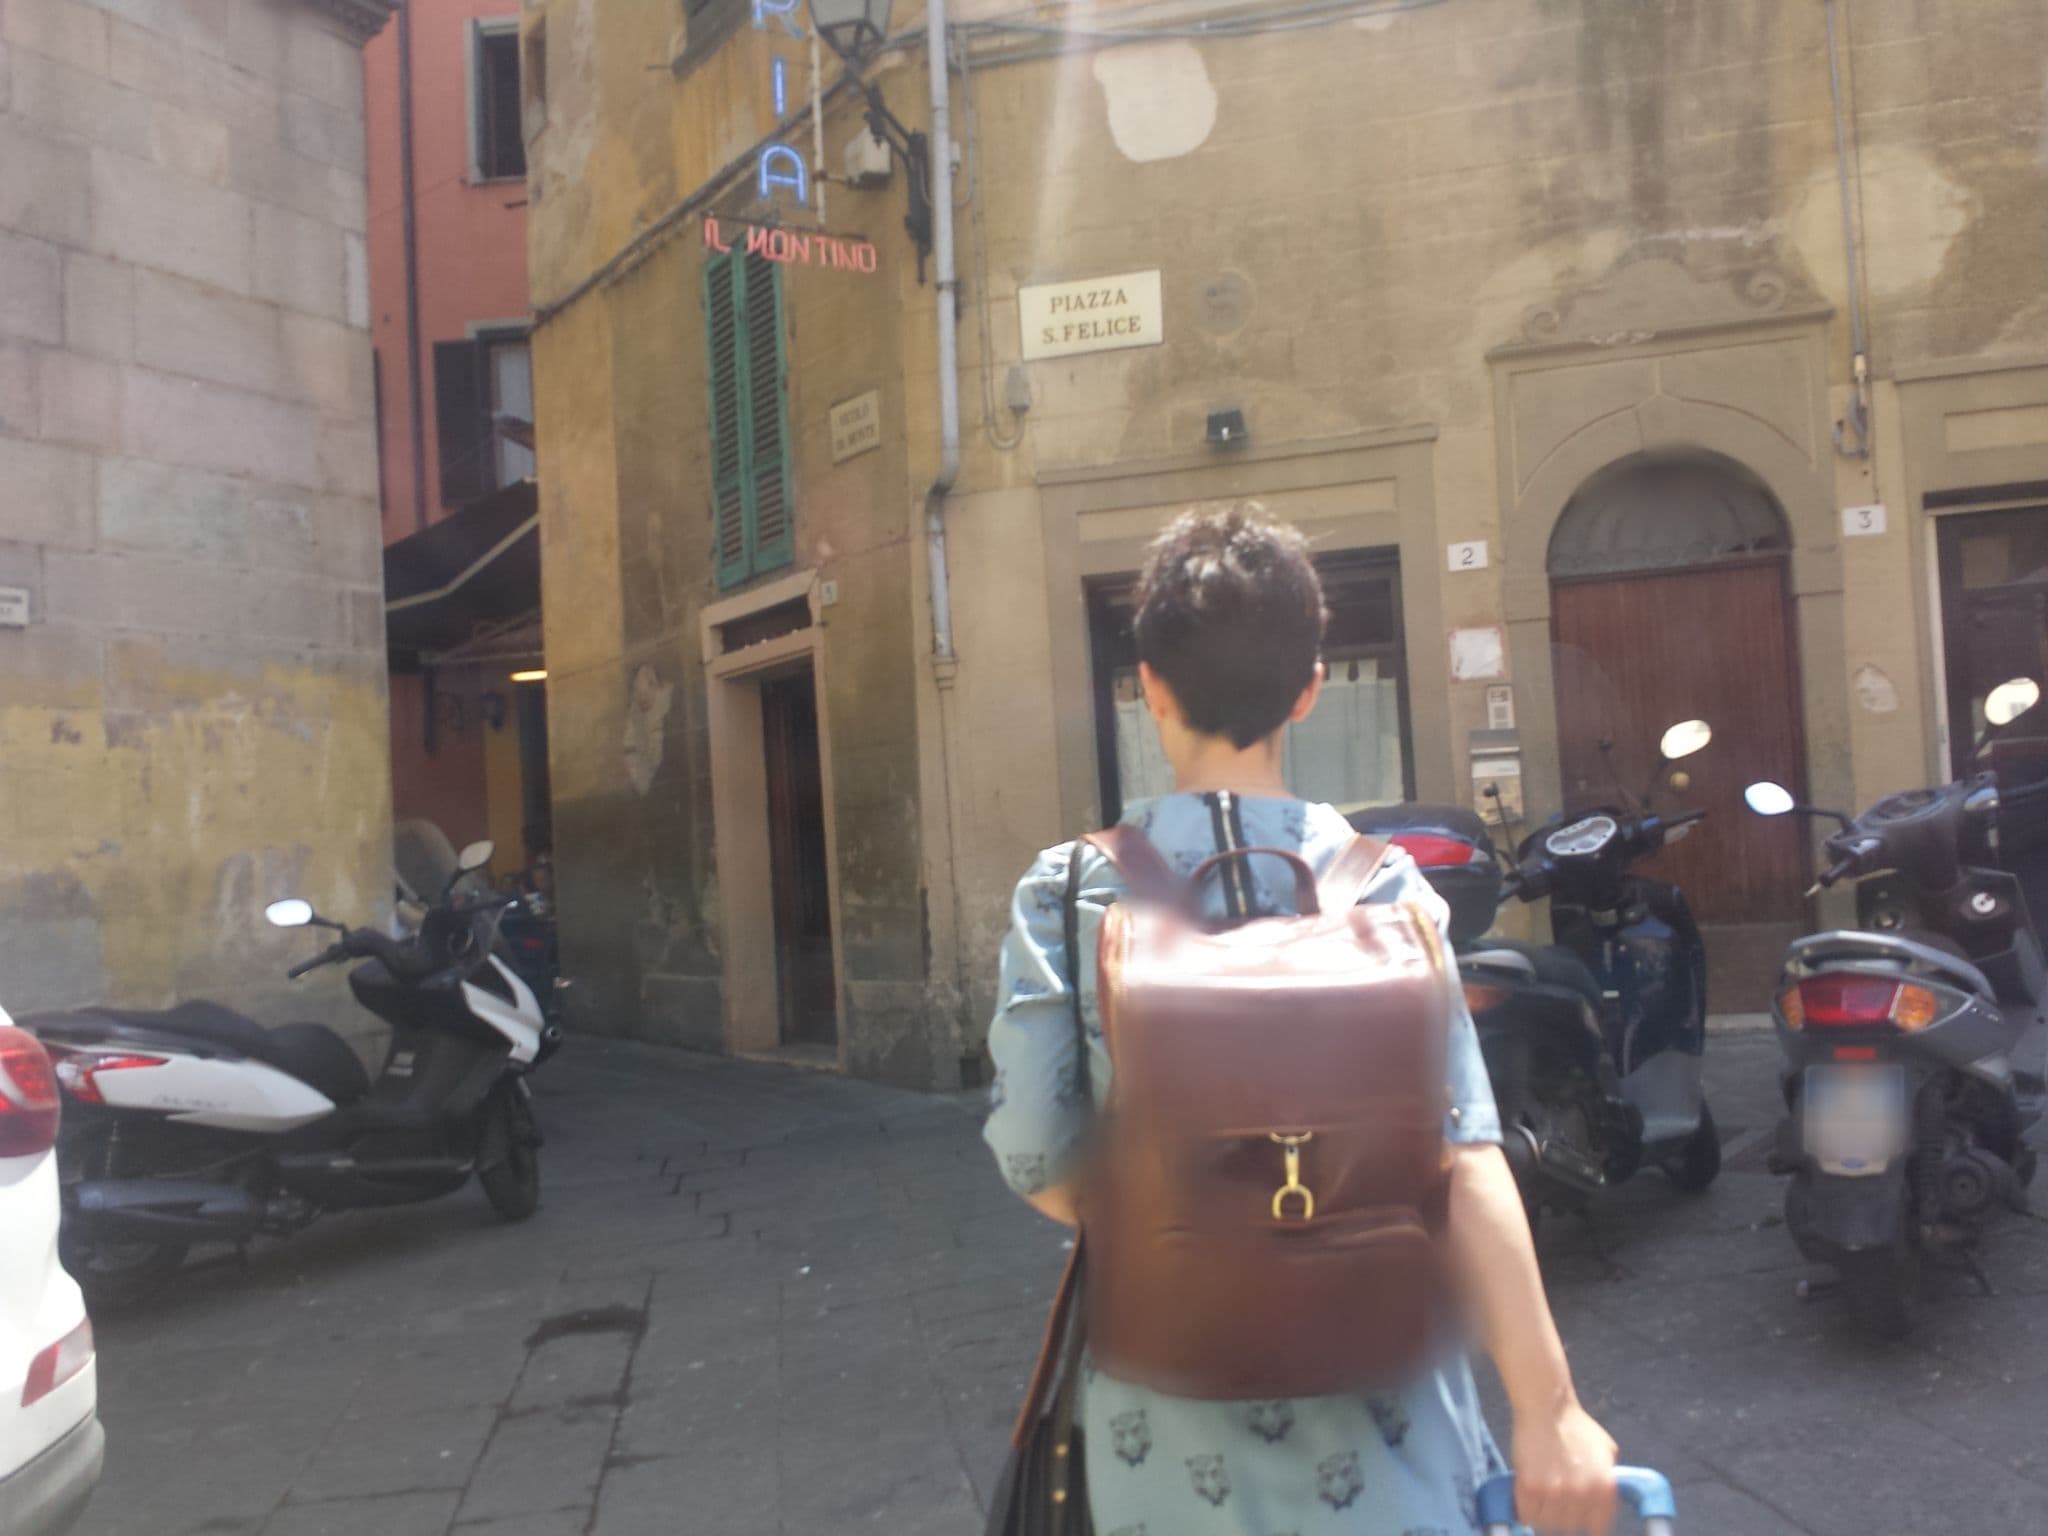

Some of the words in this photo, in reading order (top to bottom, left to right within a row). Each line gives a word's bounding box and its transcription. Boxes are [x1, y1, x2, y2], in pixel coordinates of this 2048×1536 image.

[704, 217, 732, 253] IL
[746, 224, 877, 273] MONTINO
[1050, 287, 1128, 314] PIAZZA
[1858, 509, 1873, 529] 3
[1462, 546, 1474, 566] 2
